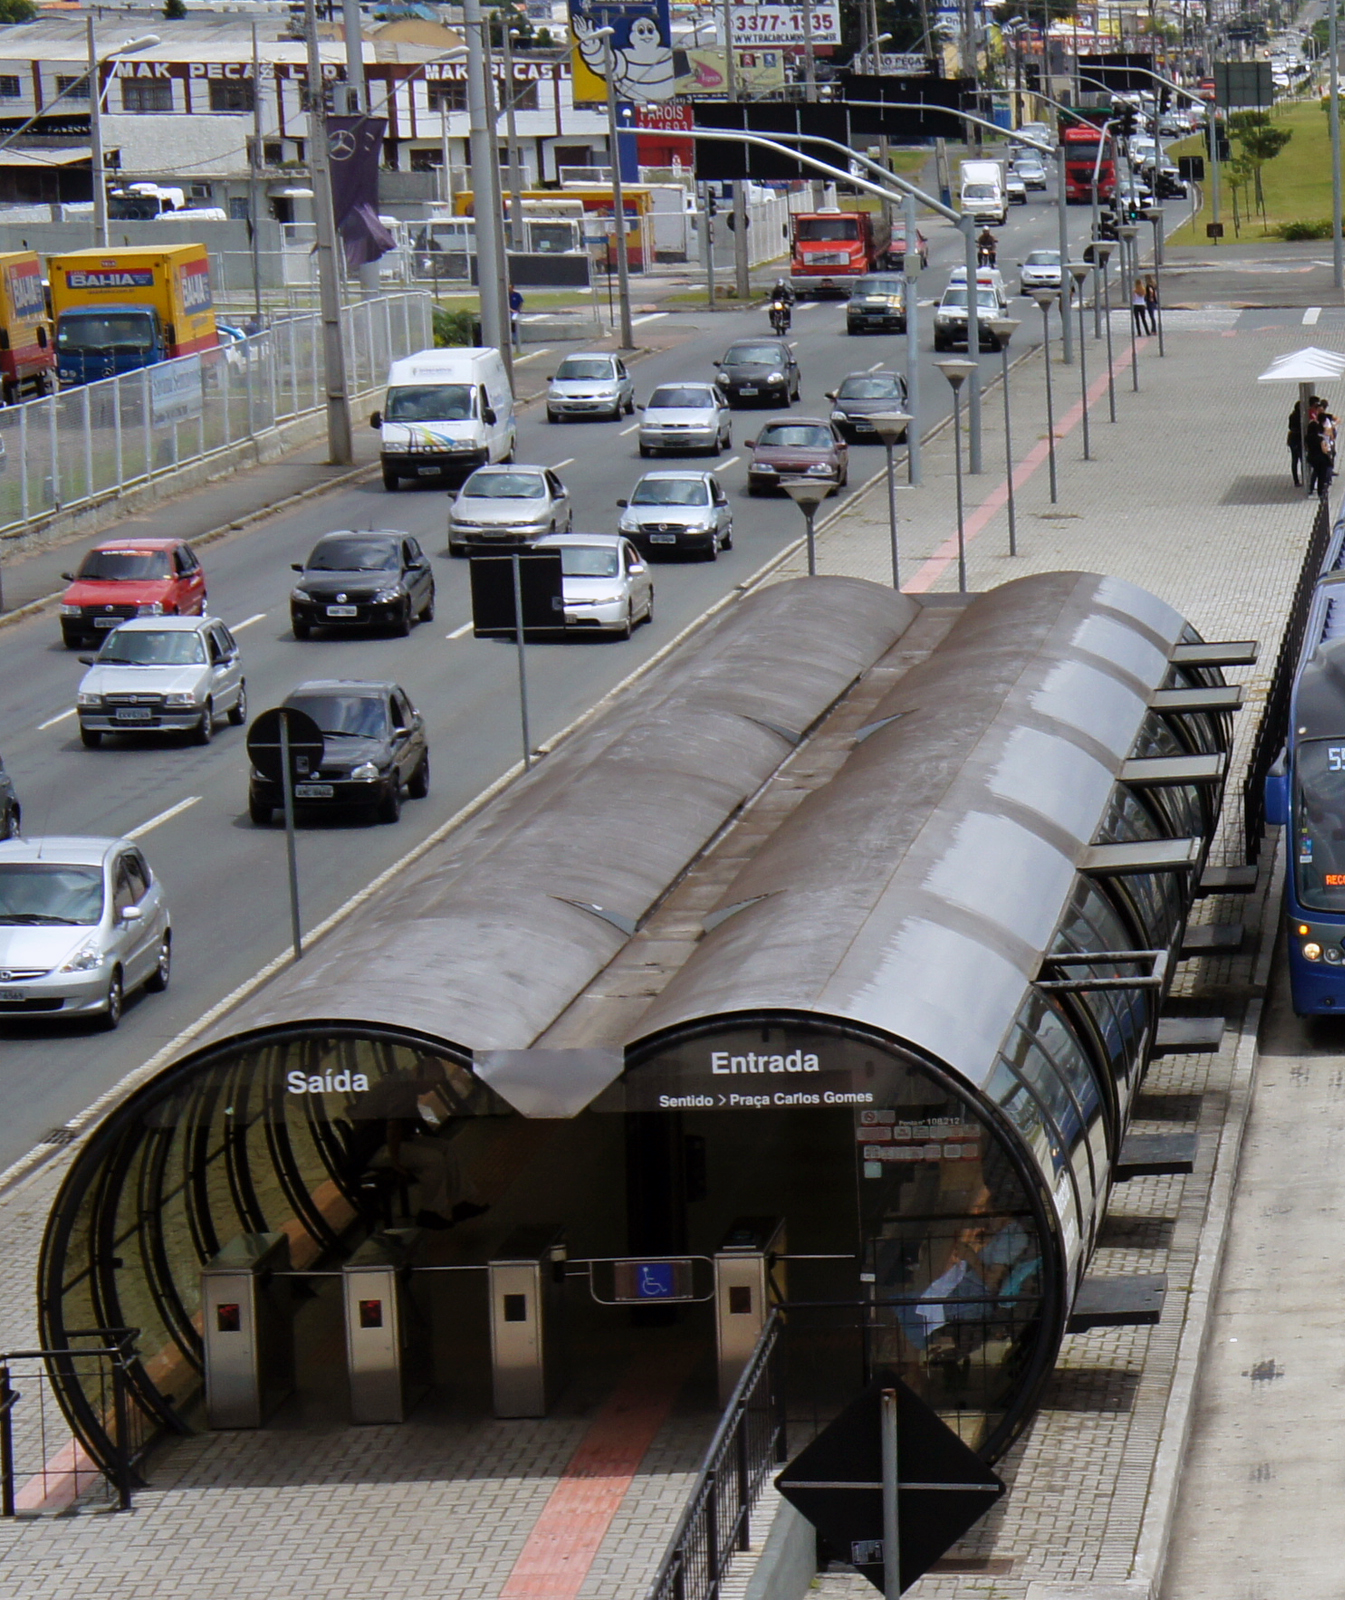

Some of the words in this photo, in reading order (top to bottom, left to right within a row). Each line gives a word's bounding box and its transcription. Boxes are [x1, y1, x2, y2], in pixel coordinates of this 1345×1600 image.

[117, 62, 171, 78] MAK
[424, 64, 468, 79] MAK
[71, 273, 136, 287] BAHIA
[711, 1049, 820, 1075] Entrada
[287, 1068, 370, 1094] Saída
[659, 1094, 714, 1108] Sentido
[730, 1093, 771, 1109] Praça
[774, 1091, 820, 1105] Carlos
[823, 1090, 874, 1104] Gomes
